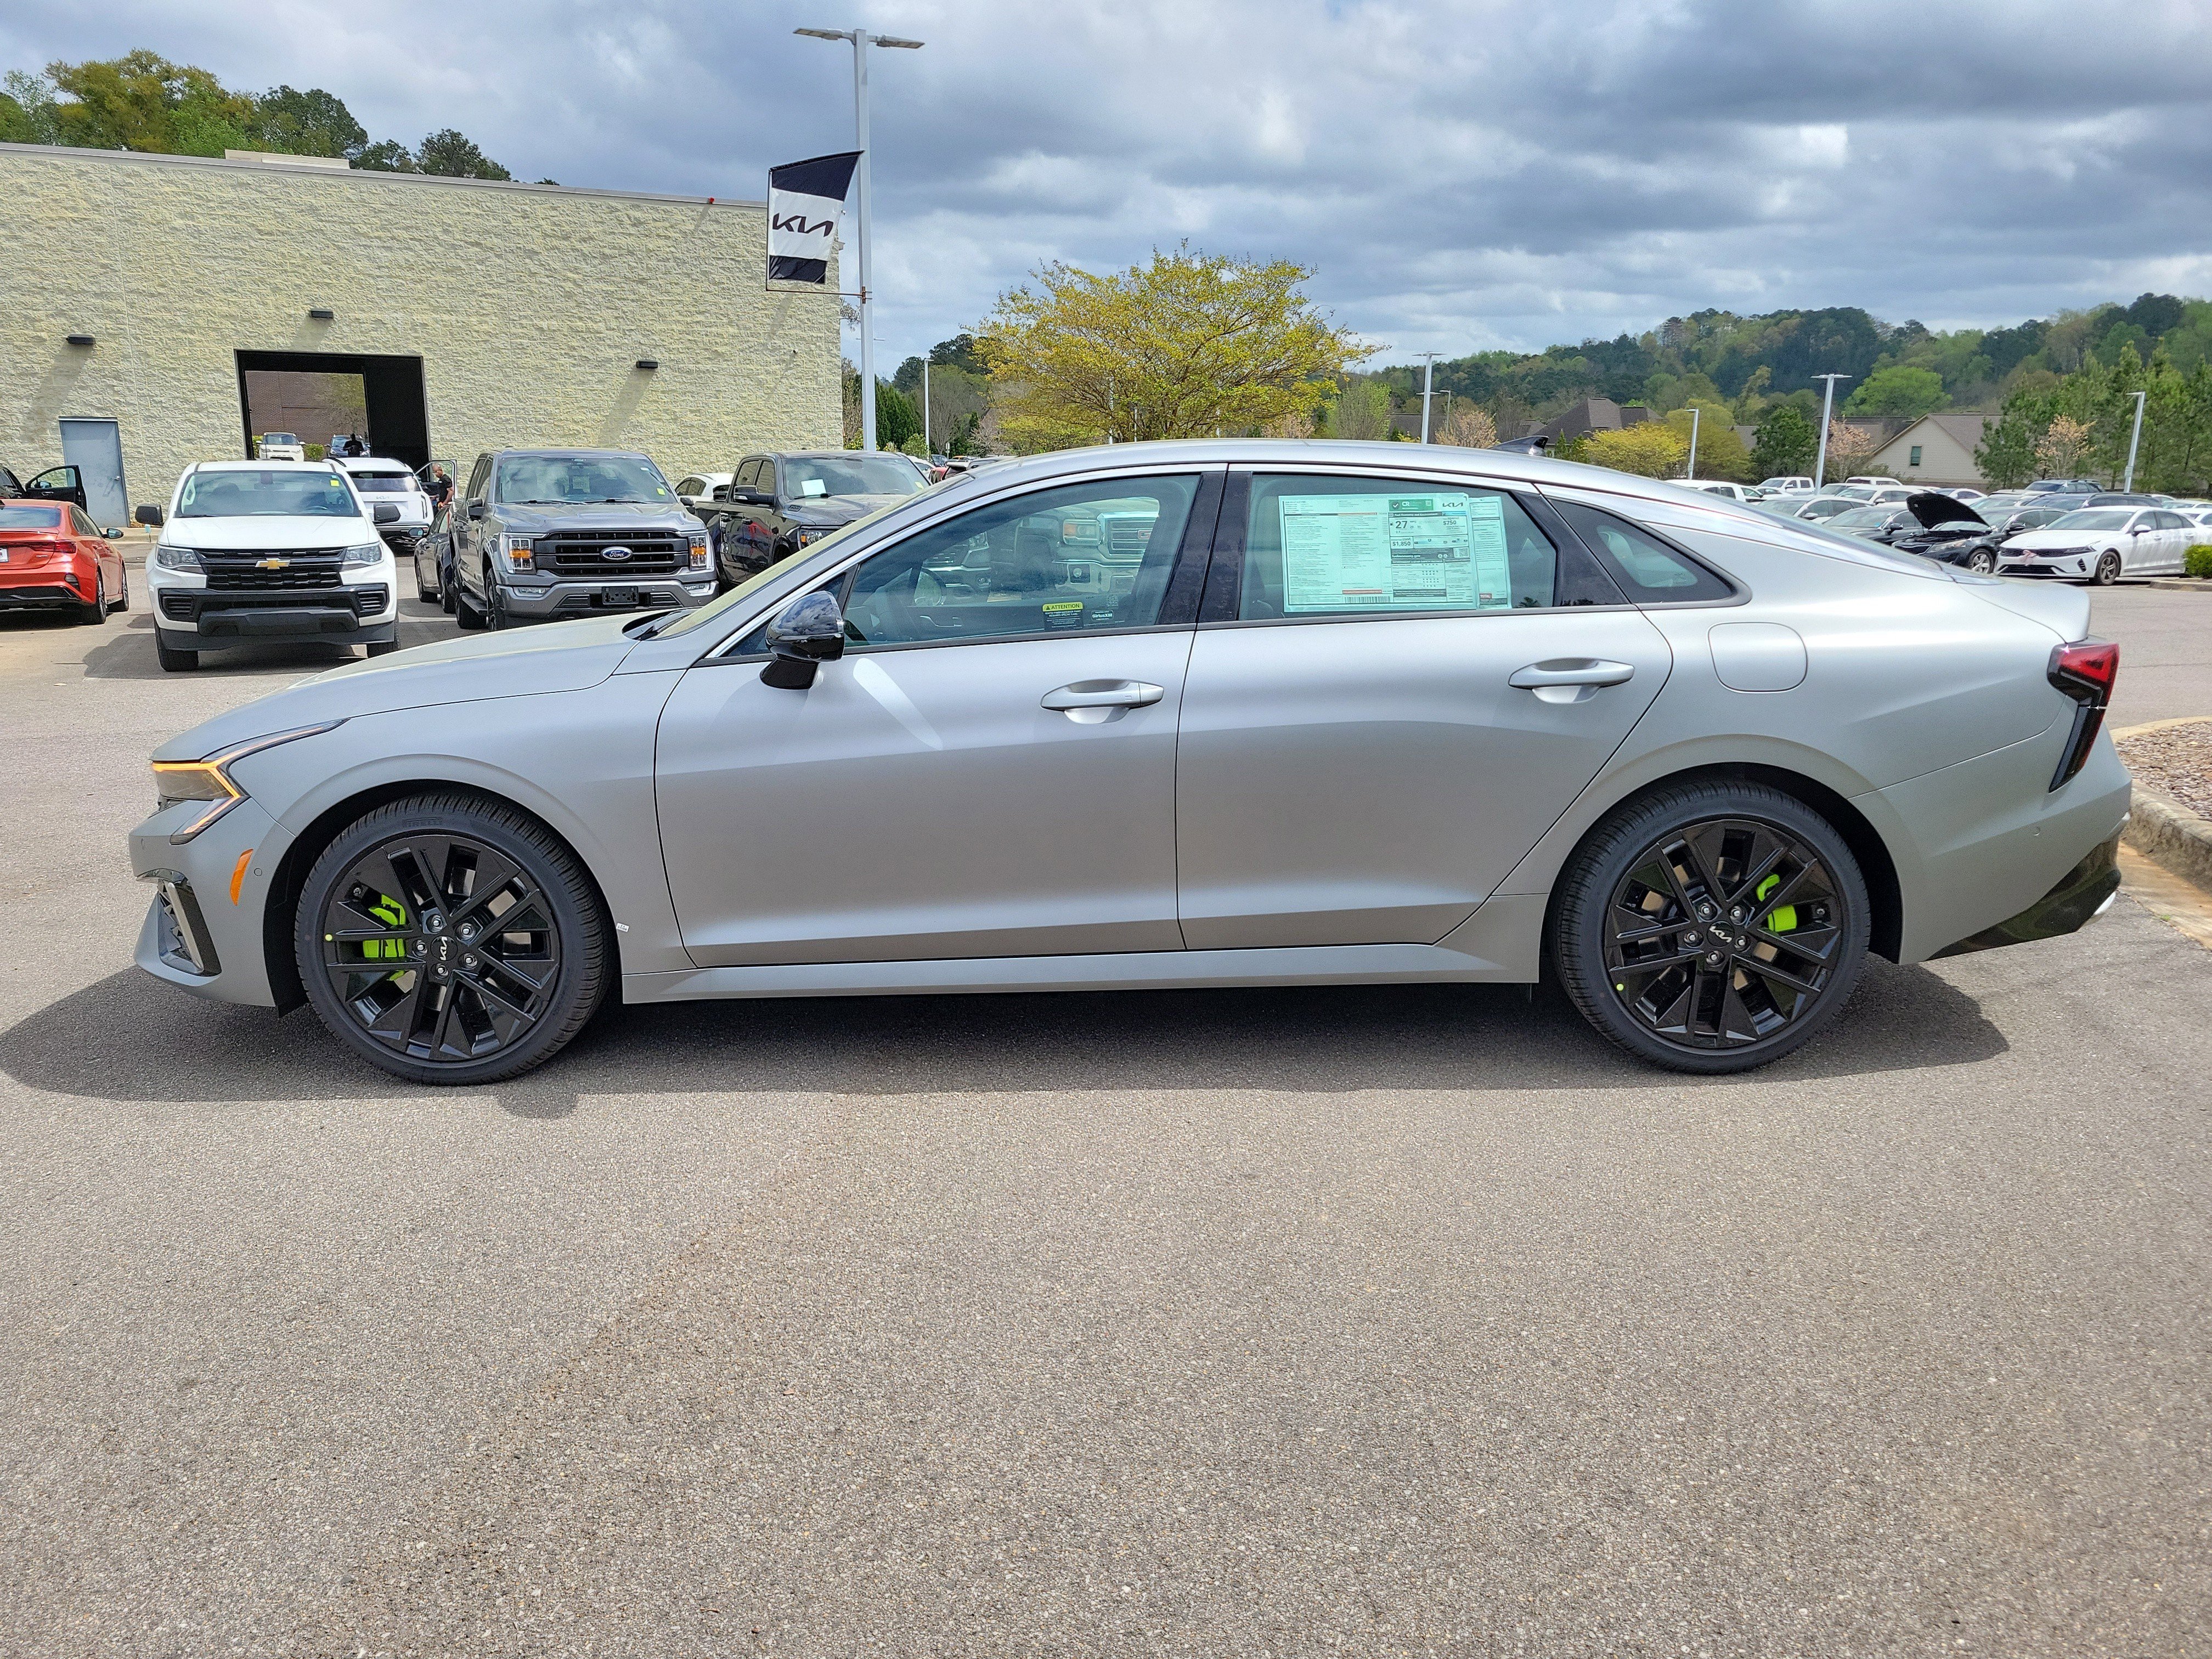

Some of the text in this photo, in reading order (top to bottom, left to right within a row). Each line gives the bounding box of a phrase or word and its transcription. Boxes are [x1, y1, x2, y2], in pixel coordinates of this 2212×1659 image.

[772, 213, 834, 237] KIA
[1396, 521, 1407, 529] 27
[1709, 926, 1733, 943] KIA
[439, 936, 448, 961] KIA
